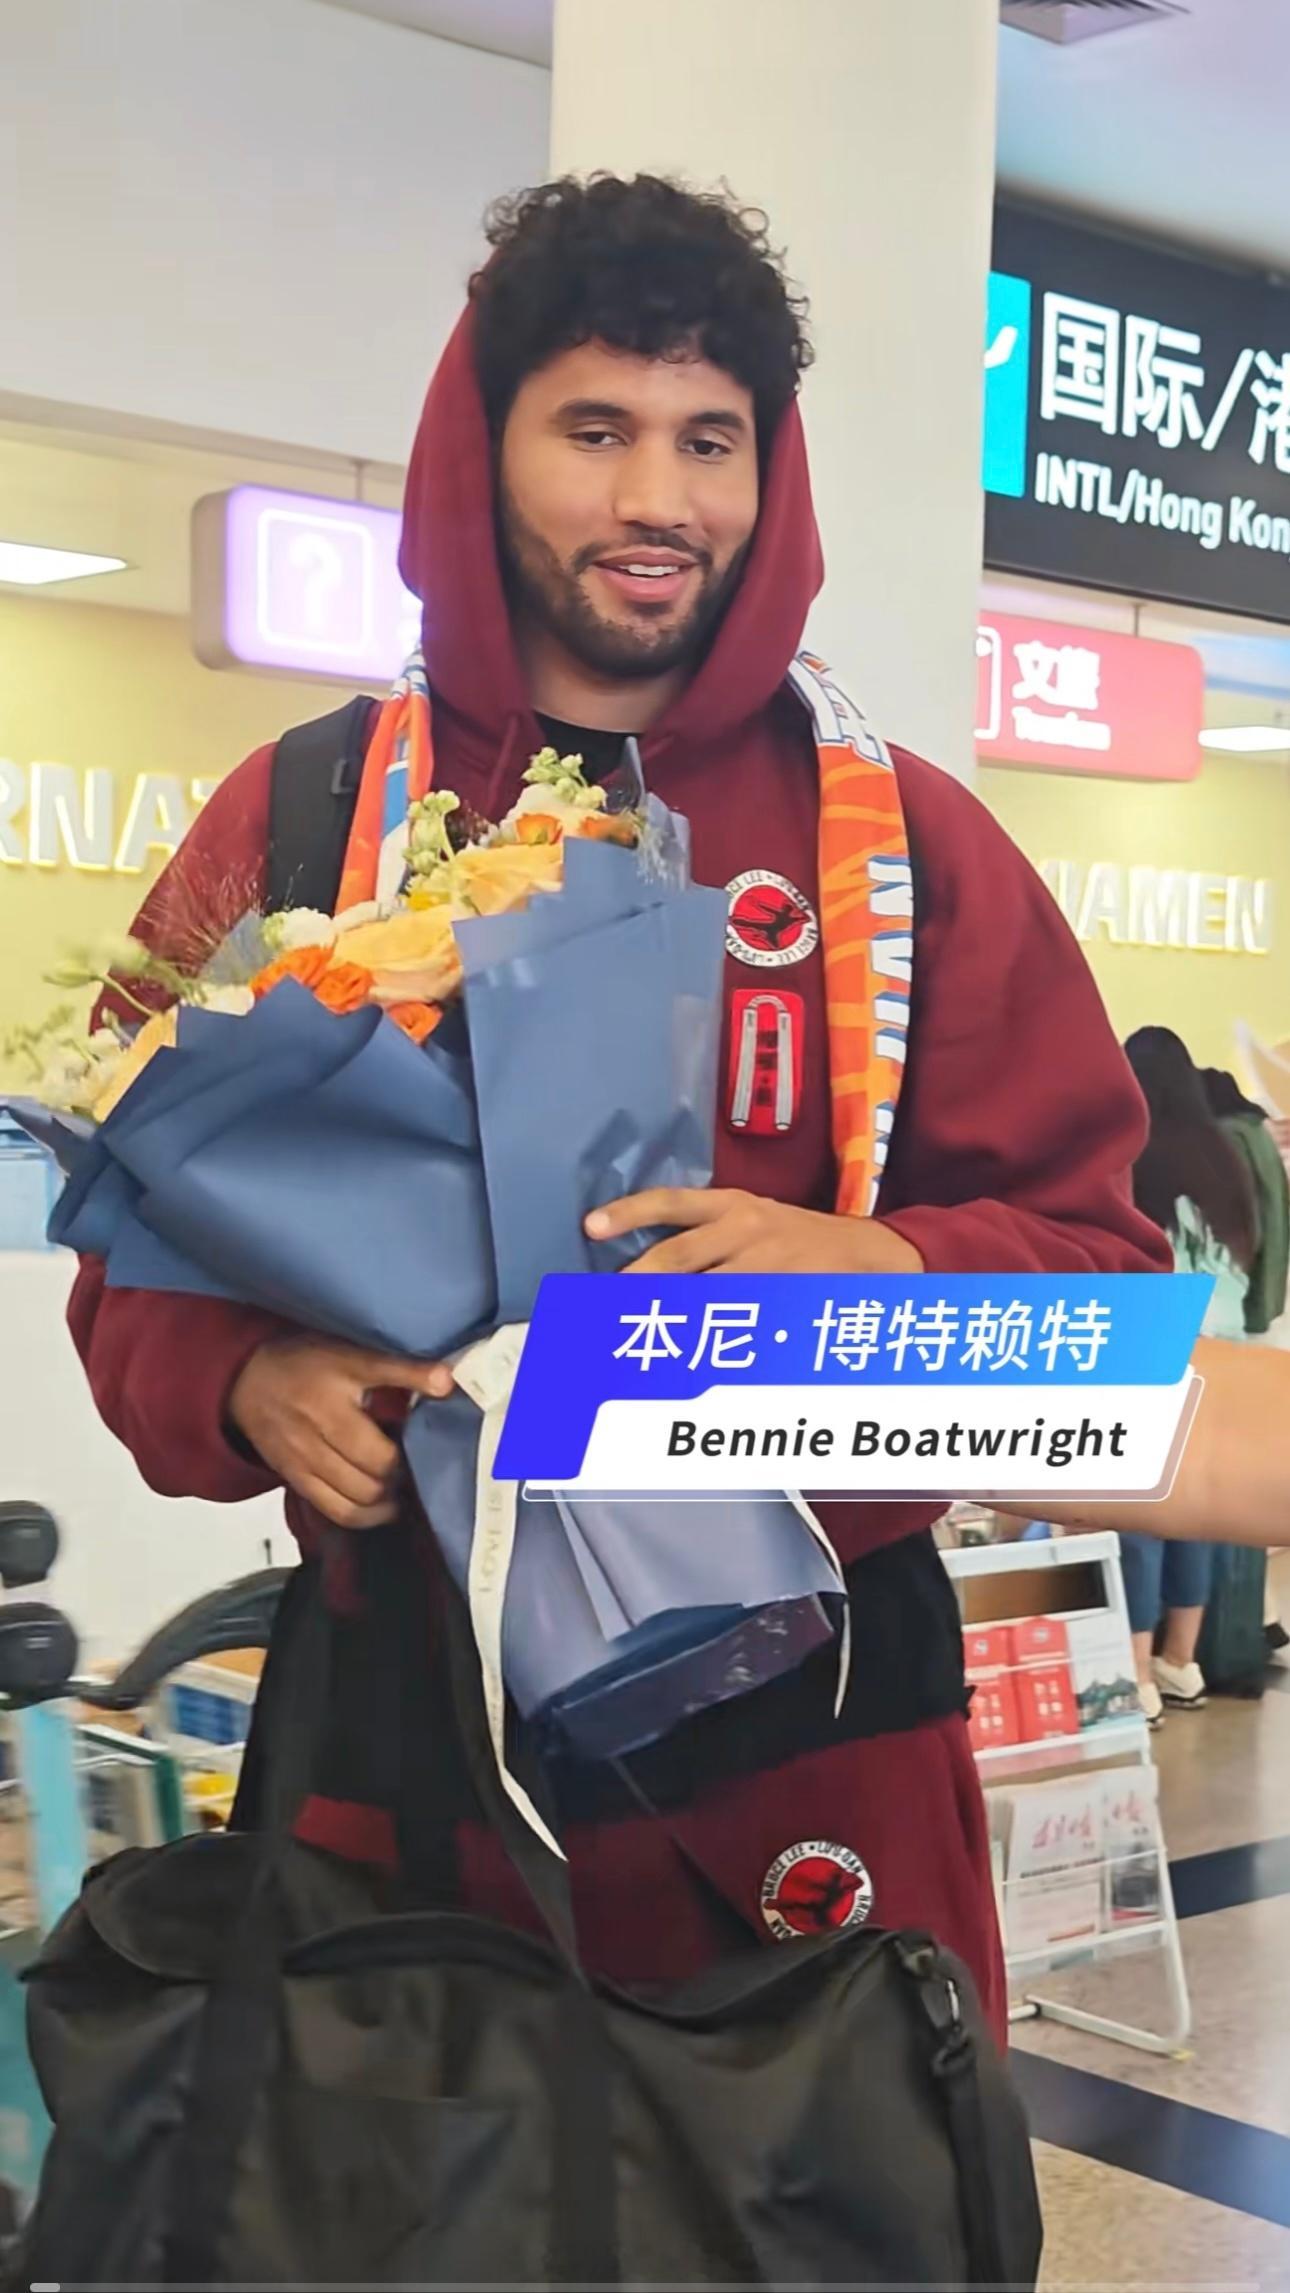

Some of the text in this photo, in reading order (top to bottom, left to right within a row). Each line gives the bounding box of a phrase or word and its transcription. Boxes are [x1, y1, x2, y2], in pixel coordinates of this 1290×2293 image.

[1034, 452, 1290, 557] INTL/Hong Kon
[1036, 860, 1271, 955] IAMEN
